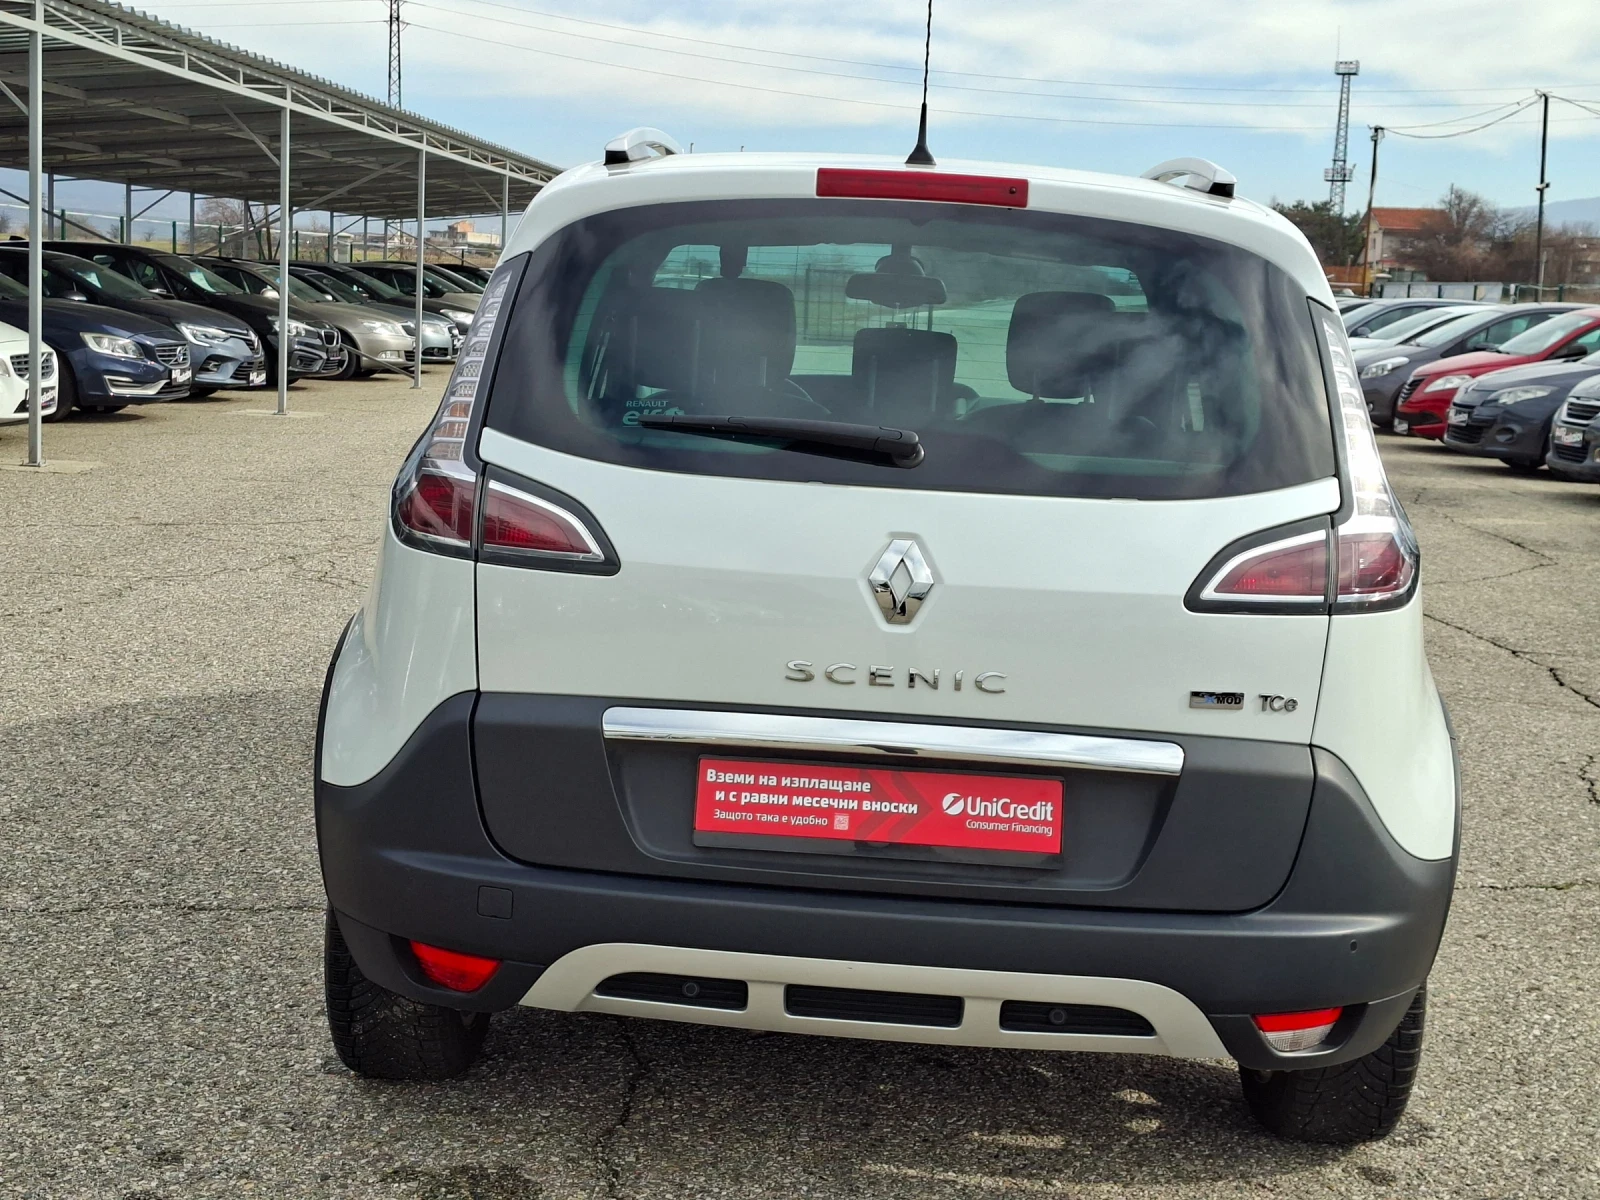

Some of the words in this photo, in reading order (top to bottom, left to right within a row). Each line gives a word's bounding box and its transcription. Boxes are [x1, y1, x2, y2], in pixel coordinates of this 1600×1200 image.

[626, 400, 668, 408] RENAULT
[785, 660, 1008, 694] SCENIC
[1258, 694, 1298, 712] TCe
[706, 768, 755, 785] Вземи
[758, 775, 777, 786] на
[781, 776, 871, 793] изплащане
[715, 790, 725, 801] и
[729, 791, 737, 802] с
[740, 791, 788, 806] равни
[792, 795, 858, 810] месечни
[862, 800, 918, 815] вноски
[966, 796, 1053, 821] UniCredit
[713, 808, 753, 821] Защото
[755, 812, 779, 823] така
[781, 815, 788, 823] е
[790, 815, 828, 826] удобно
[966, 819, 1010, 831] Consumer
[1012, 822, 1053, 836] Financing
